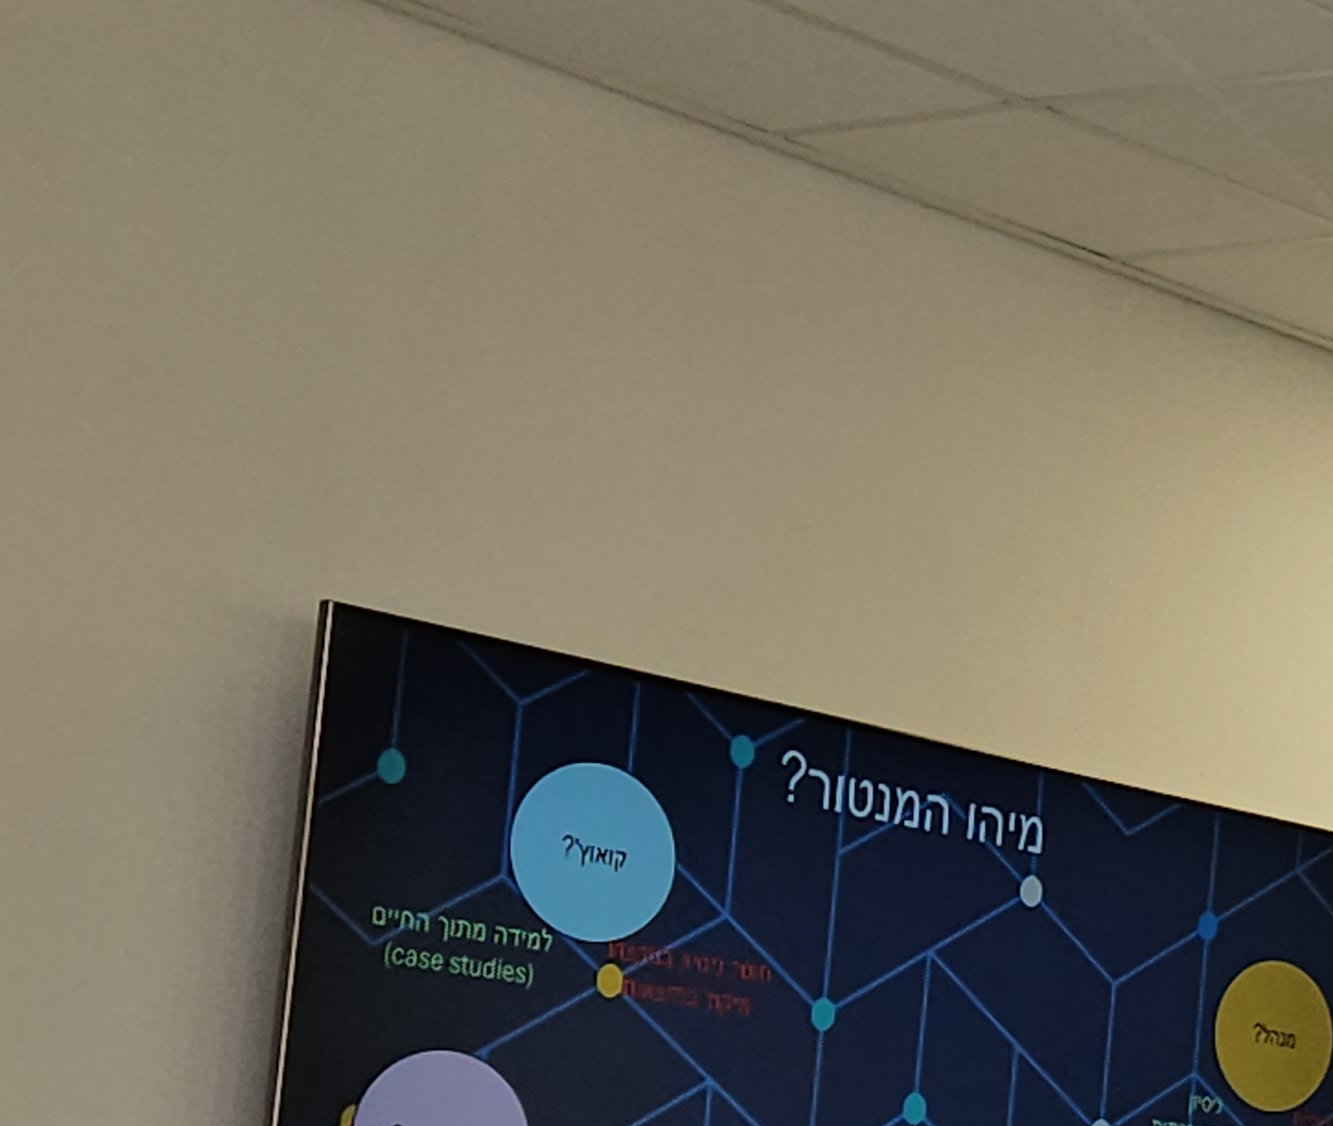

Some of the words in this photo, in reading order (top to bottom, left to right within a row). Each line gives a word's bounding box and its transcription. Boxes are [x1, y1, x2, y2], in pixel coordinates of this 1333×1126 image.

[781, 750, 949, 835] המנטור?
[966, 803, 1043, 854] מיהו
[371, 906, 430, 933] החיים
[438, 916, 487, 942] מתוך
[493, 925, 554, 953] למידה
[384, 940, 445, 972] (case
[448, 955, 535, 989] studies)
